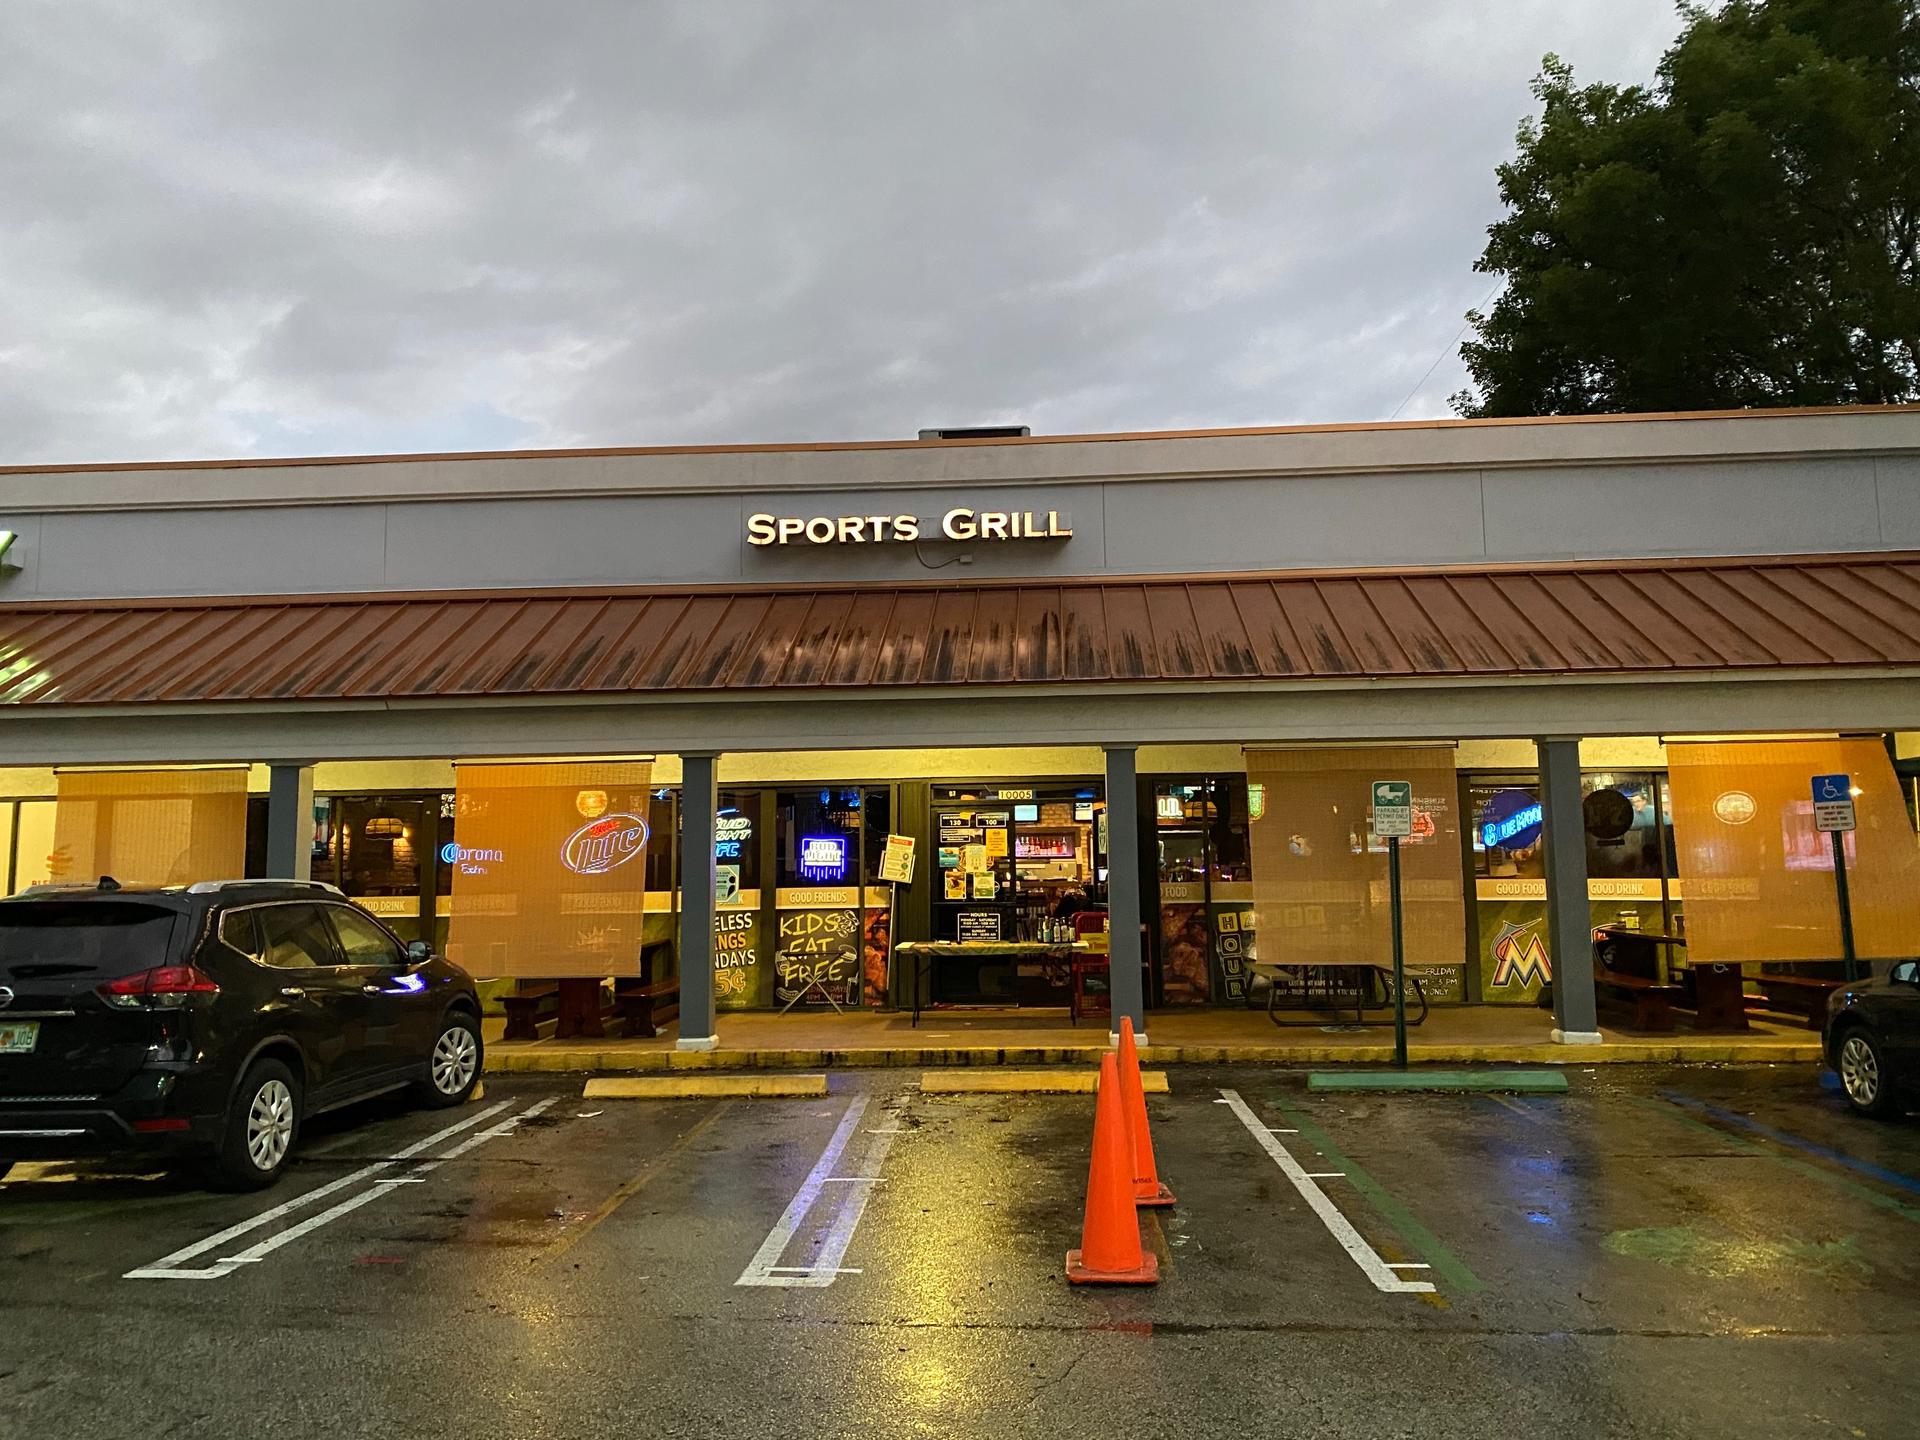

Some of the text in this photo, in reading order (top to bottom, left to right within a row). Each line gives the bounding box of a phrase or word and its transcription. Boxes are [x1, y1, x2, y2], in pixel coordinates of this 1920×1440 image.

[747, 508, 1073, 545] SPORTS GRILL
[1000, 791, 1032, 799] 10005
[1165, 886, 1187, 898] FOOD
[1496, 883, 1546, 895] GOOD FOOD
[1590, 883, 1644, 895] GOOD DRINK
[789, 891, 848, 903] GOOD FRIENDS
[380, 900, 406, 912] DRINK
[780, 913, 840, 938] KIDS
[788, 937, 835, 959] EAT
[784, 958, 845, 988] FREE
